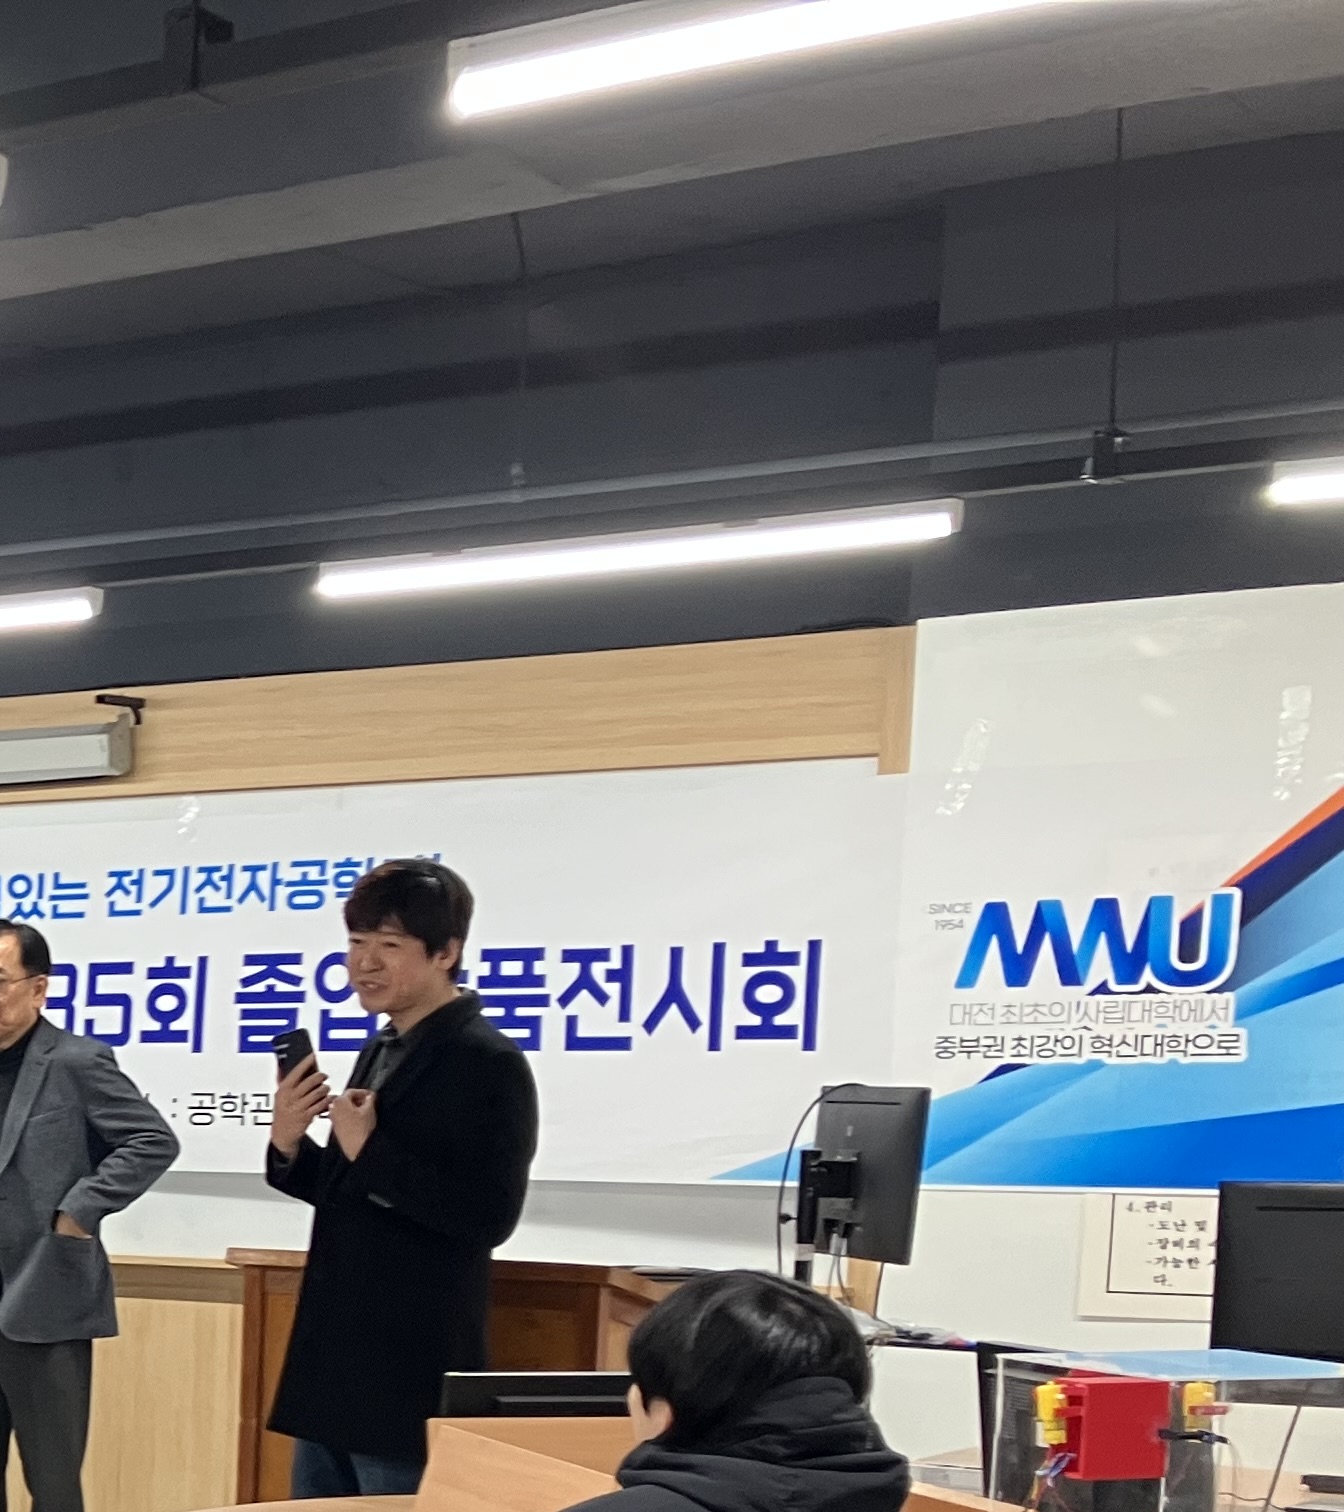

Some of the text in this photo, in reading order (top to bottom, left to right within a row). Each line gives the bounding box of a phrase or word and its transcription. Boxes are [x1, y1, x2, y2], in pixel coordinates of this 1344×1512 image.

[105, 853, 441, 917] 전기전자공학
[928, 902, 973, 915] SINCE
[233, 938, 822, 1053] 졸업품전시회
[949, 998, 1230, 1026] 대전 최초의 사립대학에서
[935, 1033, 1242, 1060] 중부권 최강의 혁신대학으로
